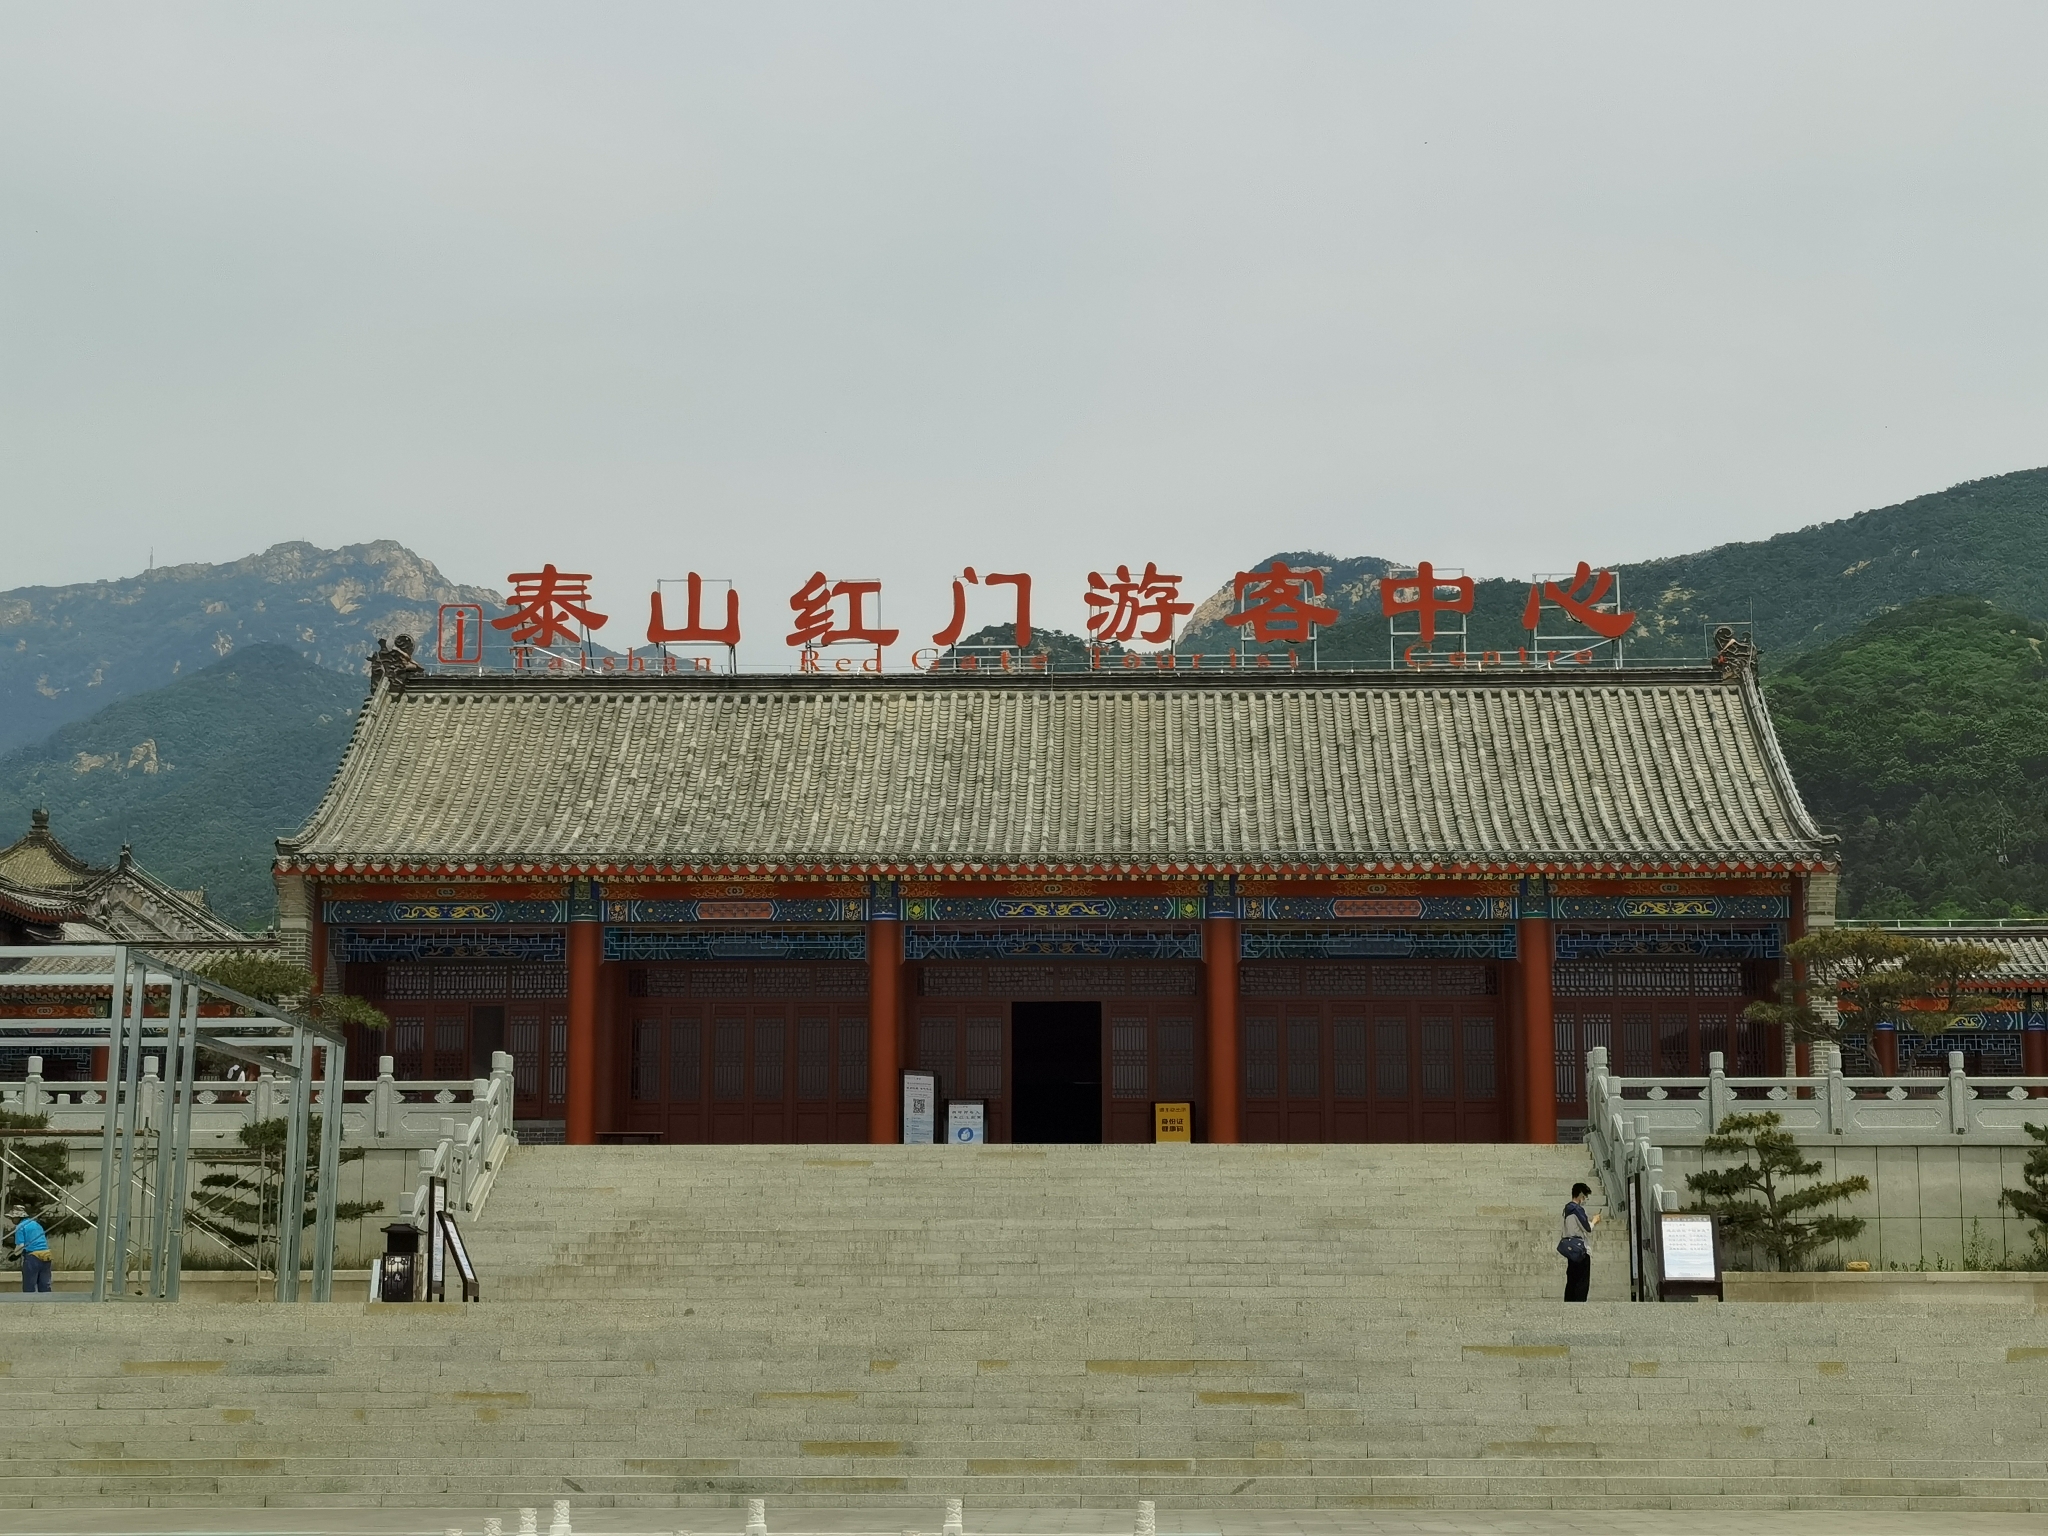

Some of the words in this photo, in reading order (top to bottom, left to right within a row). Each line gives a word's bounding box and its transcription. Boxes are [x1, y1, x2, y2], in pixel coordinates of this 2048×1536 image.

[491, 561, 1635, 648] 泰山红门游客中心
[510, 645, 711, 672] Taishan
[797, 647, 881, 673] Red
[911, 647, 1048, 673] Gate
[1086, 646, 1298, 669] Tourist
[1404, 643, 1592, 666] Centre
